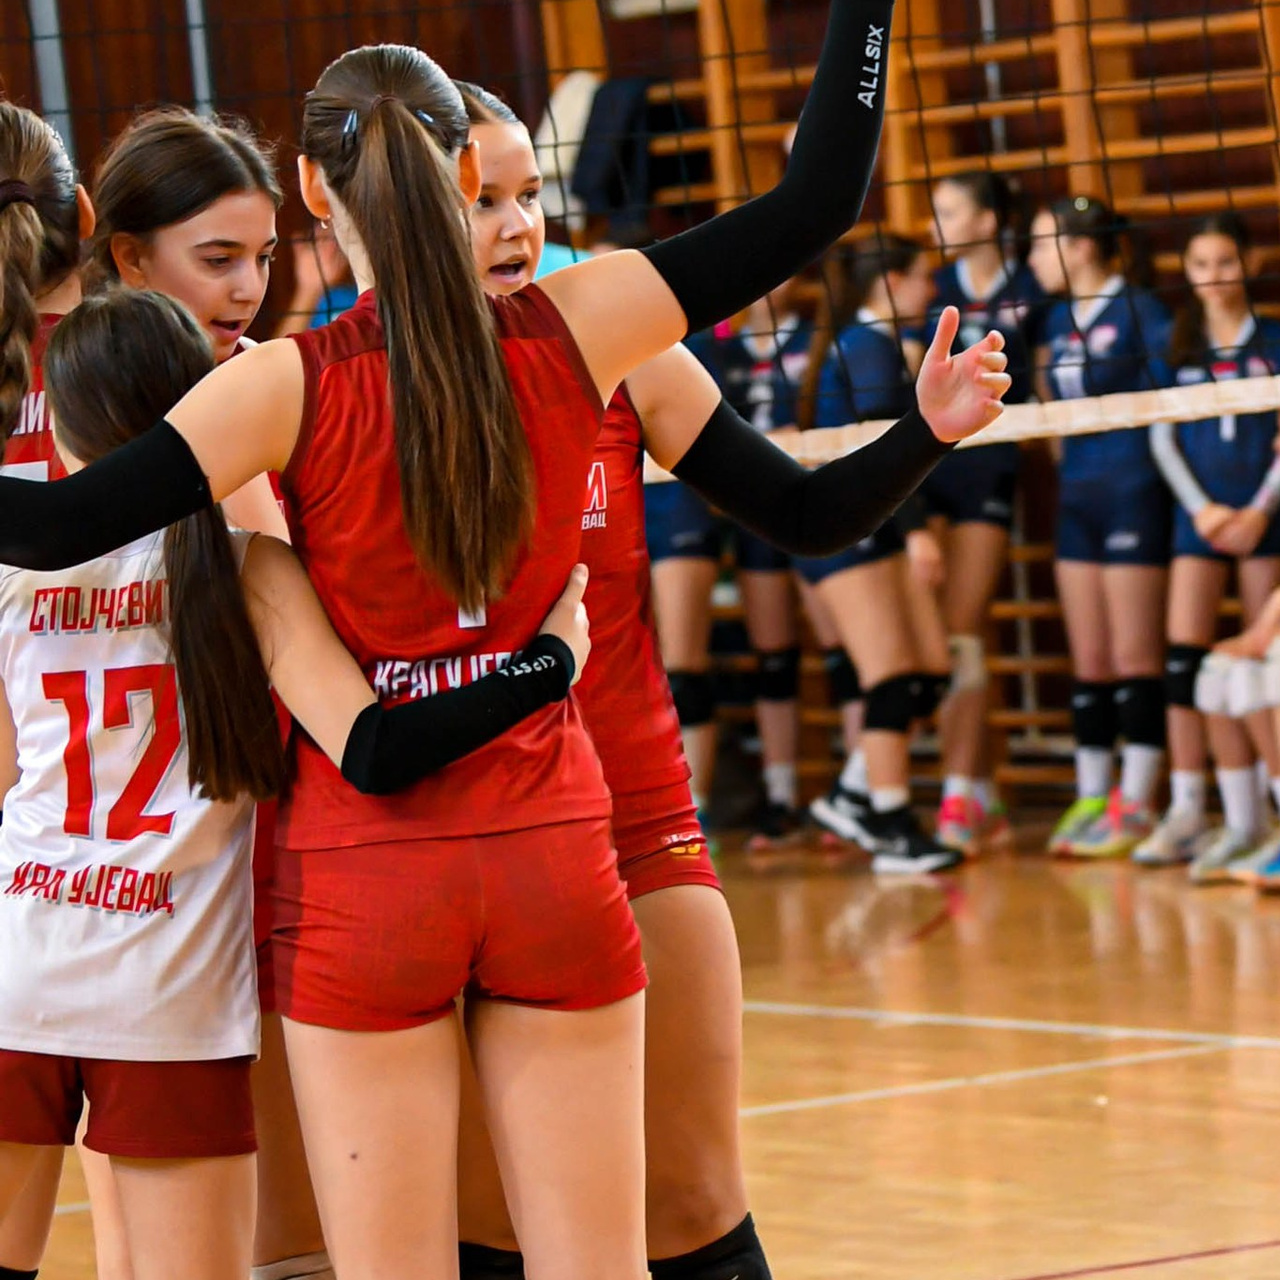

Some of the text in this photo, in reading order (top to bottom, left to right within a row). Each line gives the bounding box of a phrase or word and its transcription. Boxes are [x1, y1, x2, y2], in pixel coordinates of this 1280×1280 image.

[857, 24, 884, 109] ALLSIX
[29, 579, 170, 635] СТОЈЧЕВИ
[41, 663, 183, 842] 12
